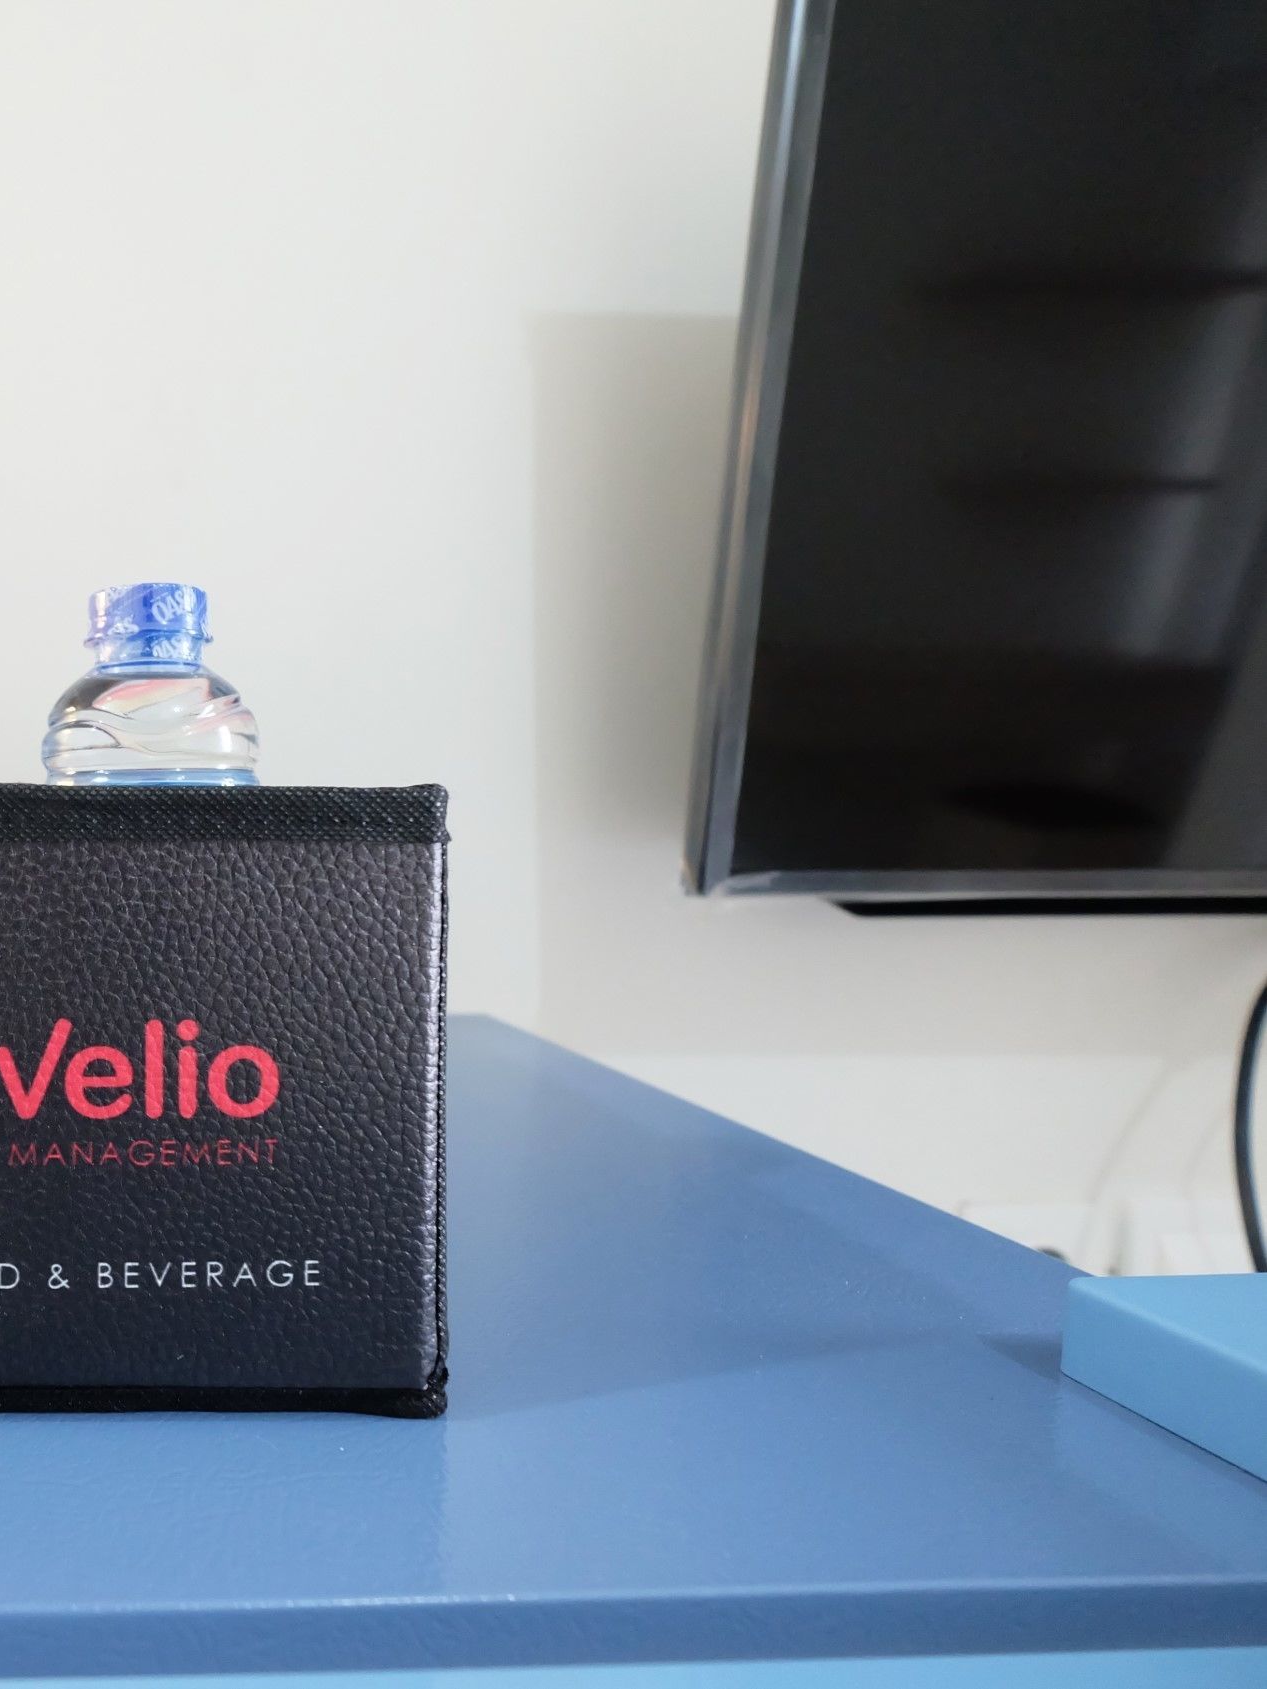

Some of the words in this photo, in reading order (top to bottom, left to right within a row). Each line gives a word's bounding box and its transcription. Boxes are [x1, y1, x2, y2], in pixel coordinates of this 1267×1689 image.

[7, 1137, 280, 1168] MANAGEMENT
[47, 1263, 71, 1290] &
[97, 1259, 321, 1289] BEVERAGE
